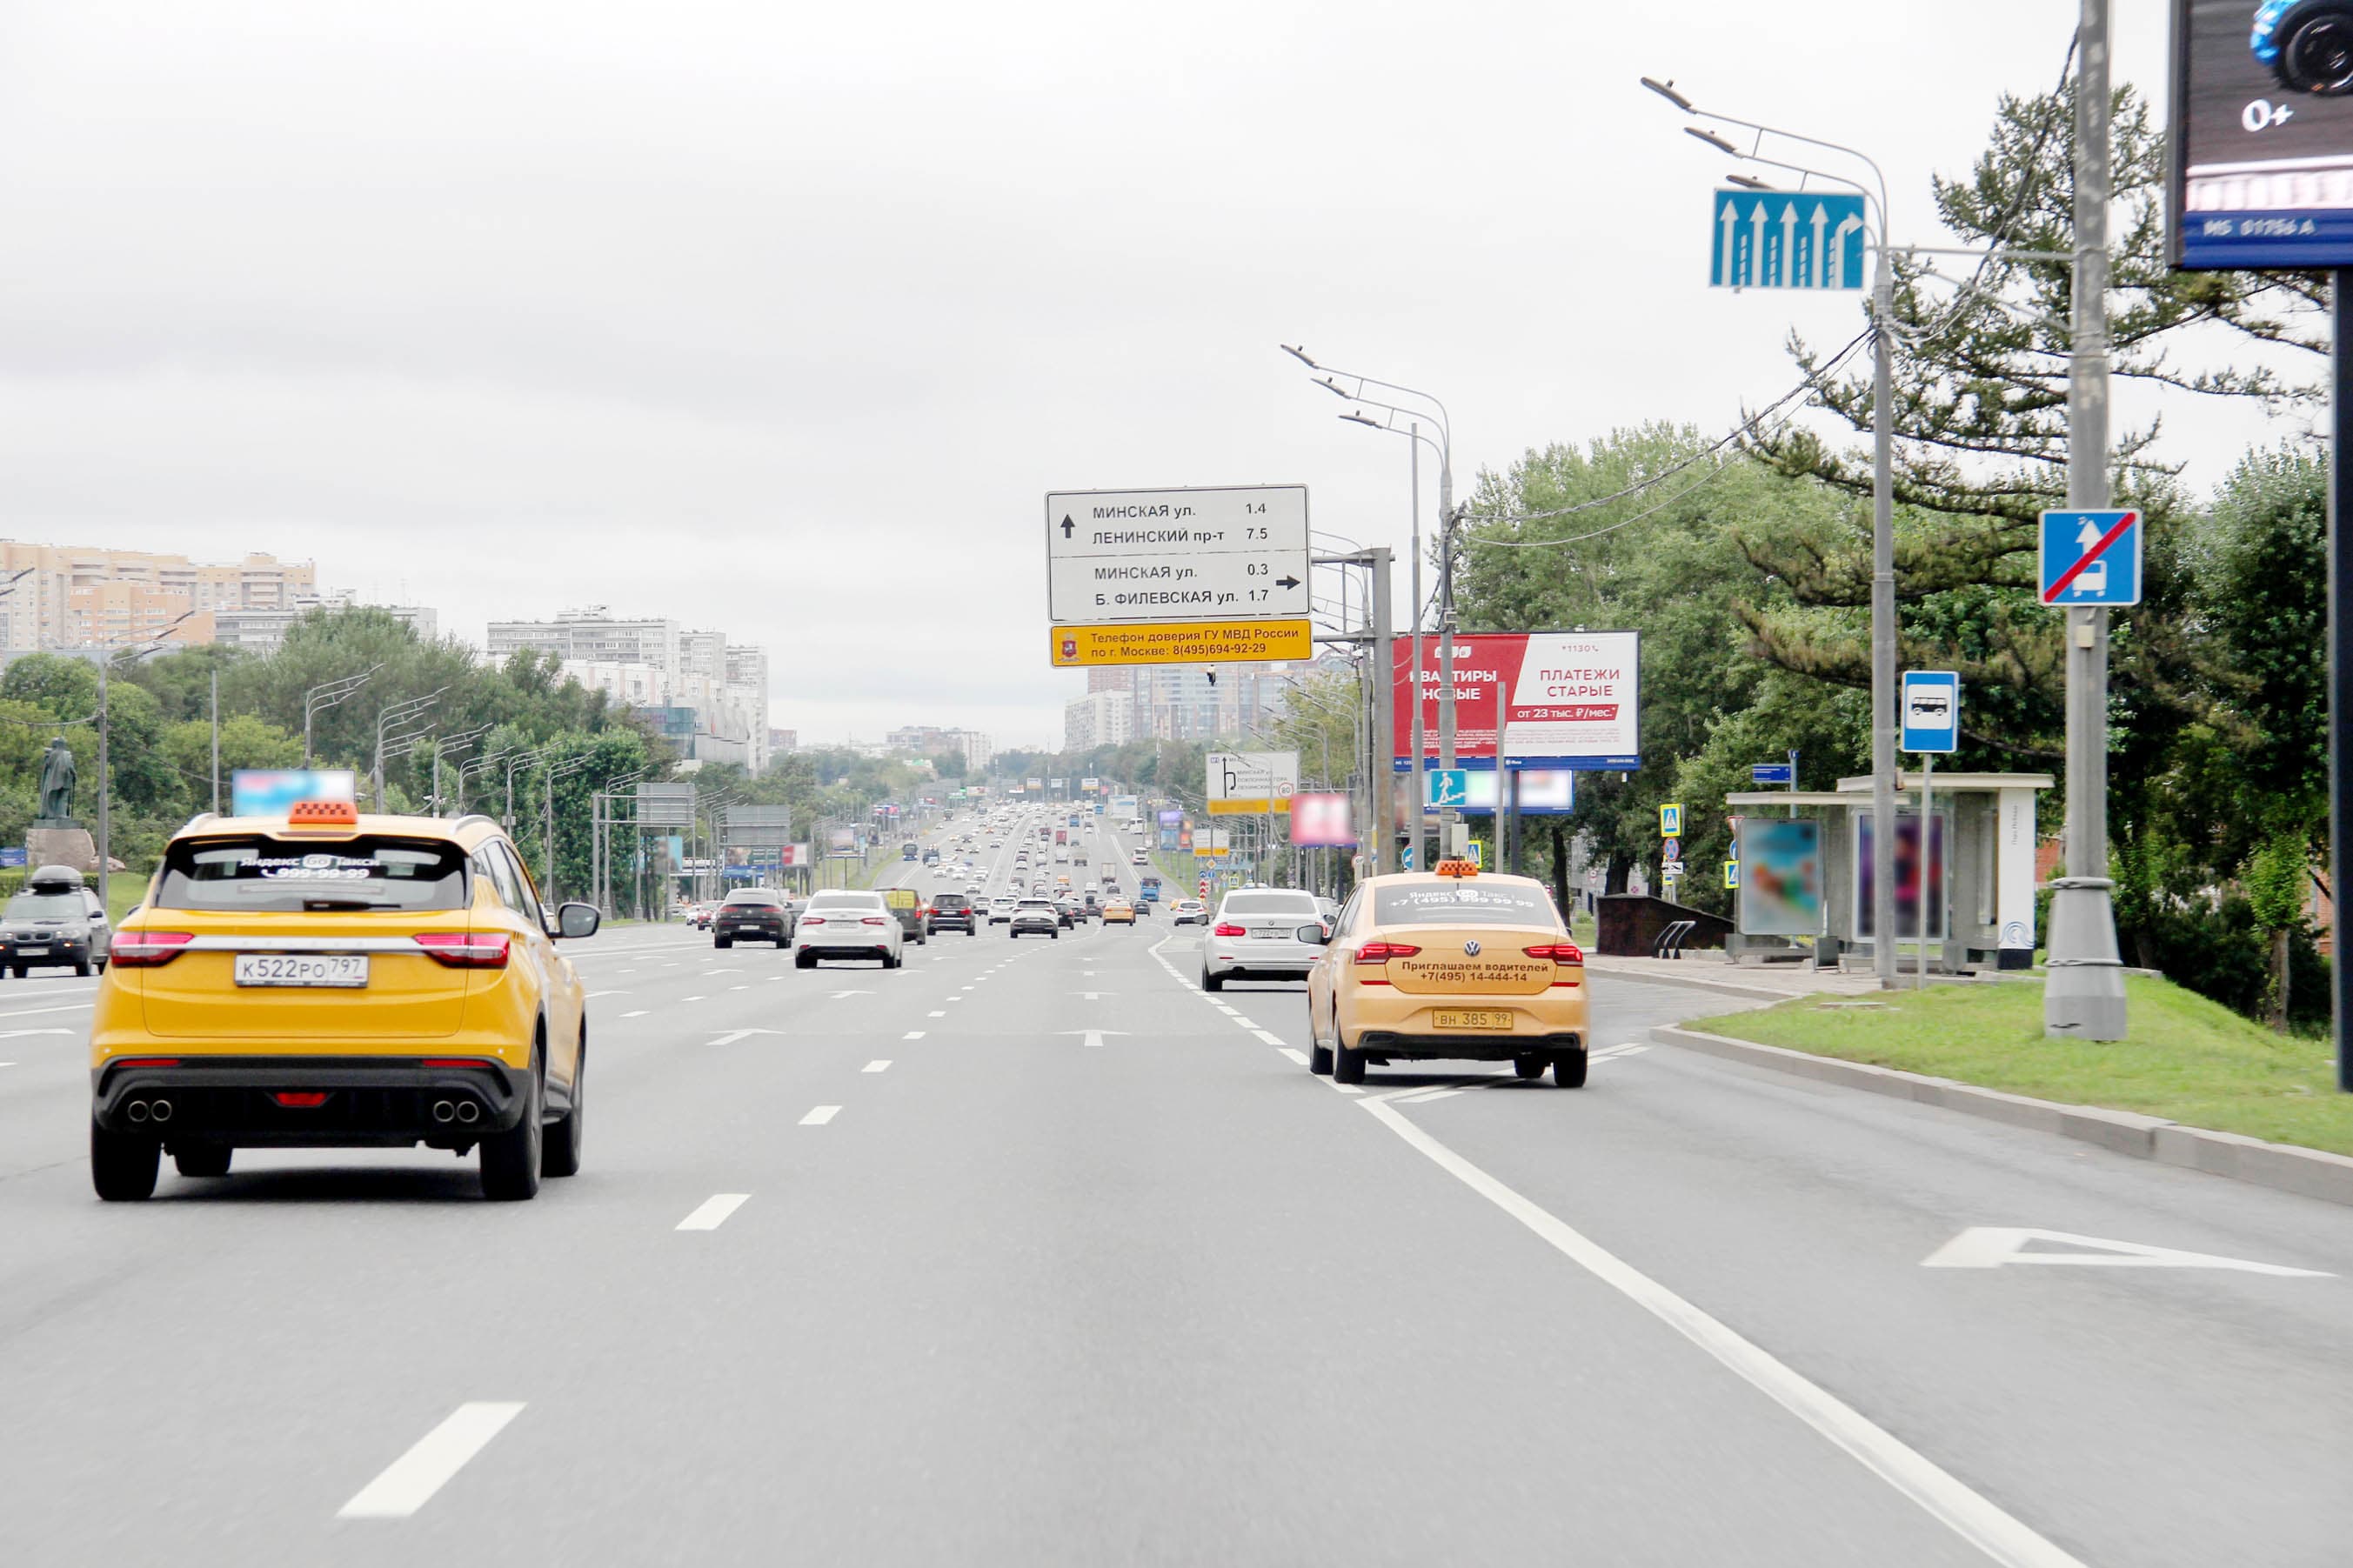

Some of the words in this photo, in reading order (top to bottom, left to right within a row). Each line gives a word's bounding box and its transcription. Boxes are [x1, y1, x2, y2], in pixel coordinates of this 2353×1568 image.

[2242, 98, 2294, 132] 0+
[1093, 504, 1169, 519] МИНСКАЯ
[1173, 506, 1196, 519] ул.
[1246, 503, 1267, 514] 1.4
[1093, 527, 1188, 544] ЛЕНИНСКИЙ
[1193, 530, 1225, 544] пр-т
[1247, 528, 1267, 540] 7.5
[1094, 566, 1171, 580] МИНСКАЯ
[1175, 568, 1198, 580] ул.
[1247, 564, 1268, 576] 0.3
[1095, 594, 1110, 605] Б.
[1114, 591, 1212, 605] ФИЛЕВСКАЯ
[1217, 592, 1239, 605] ул.
[1248, 590, 1269, 602] 1.7
[1090, 632, 1145, 644] Телефон
[1147, 632, 1200, 644] доверия
[1204, 630, 1219, 640] ГУ
[1222, 629, 1250, 641] МВД
[1253, 628, 1300, 639] России
[1091, 648, 1106, 658] по
[1110, 648, 1118, 657] г.
[1120, 645, 1170, 657] Москве:
[1173, 643, 1267, 657] 8(495)694-92-29
[1540, 669, 1621, 682] ПЛАТЕЖИ
[1547, 684, 1614, 697] СТАРЫЕ
[1517, 710, 1531, 719] от
[1534, 708, 1549, 719] 23
[1552, 708, 1574, 718] тыс.
[240, 857, 300, 868] Яндекс
[336, 857, 381, 866] Такси
[277, 868, 371, 878] 999-99-99
[244, 959, 326, 978] К522РО
[331, 958, 362, 972] 797
[1402, 961, 1481, 971] Приглашаем
[1485, 963, 1548, 972] водителей
[1420, 971, 1466, 983] +7(495)
[1471, 972, 1527, 982] 14-444-14
[1441, 1017, 1456, 1025] ВН
[1462, 1013, 1487, 1025] 385
[1494, 1014, 1507, 1024] 99
